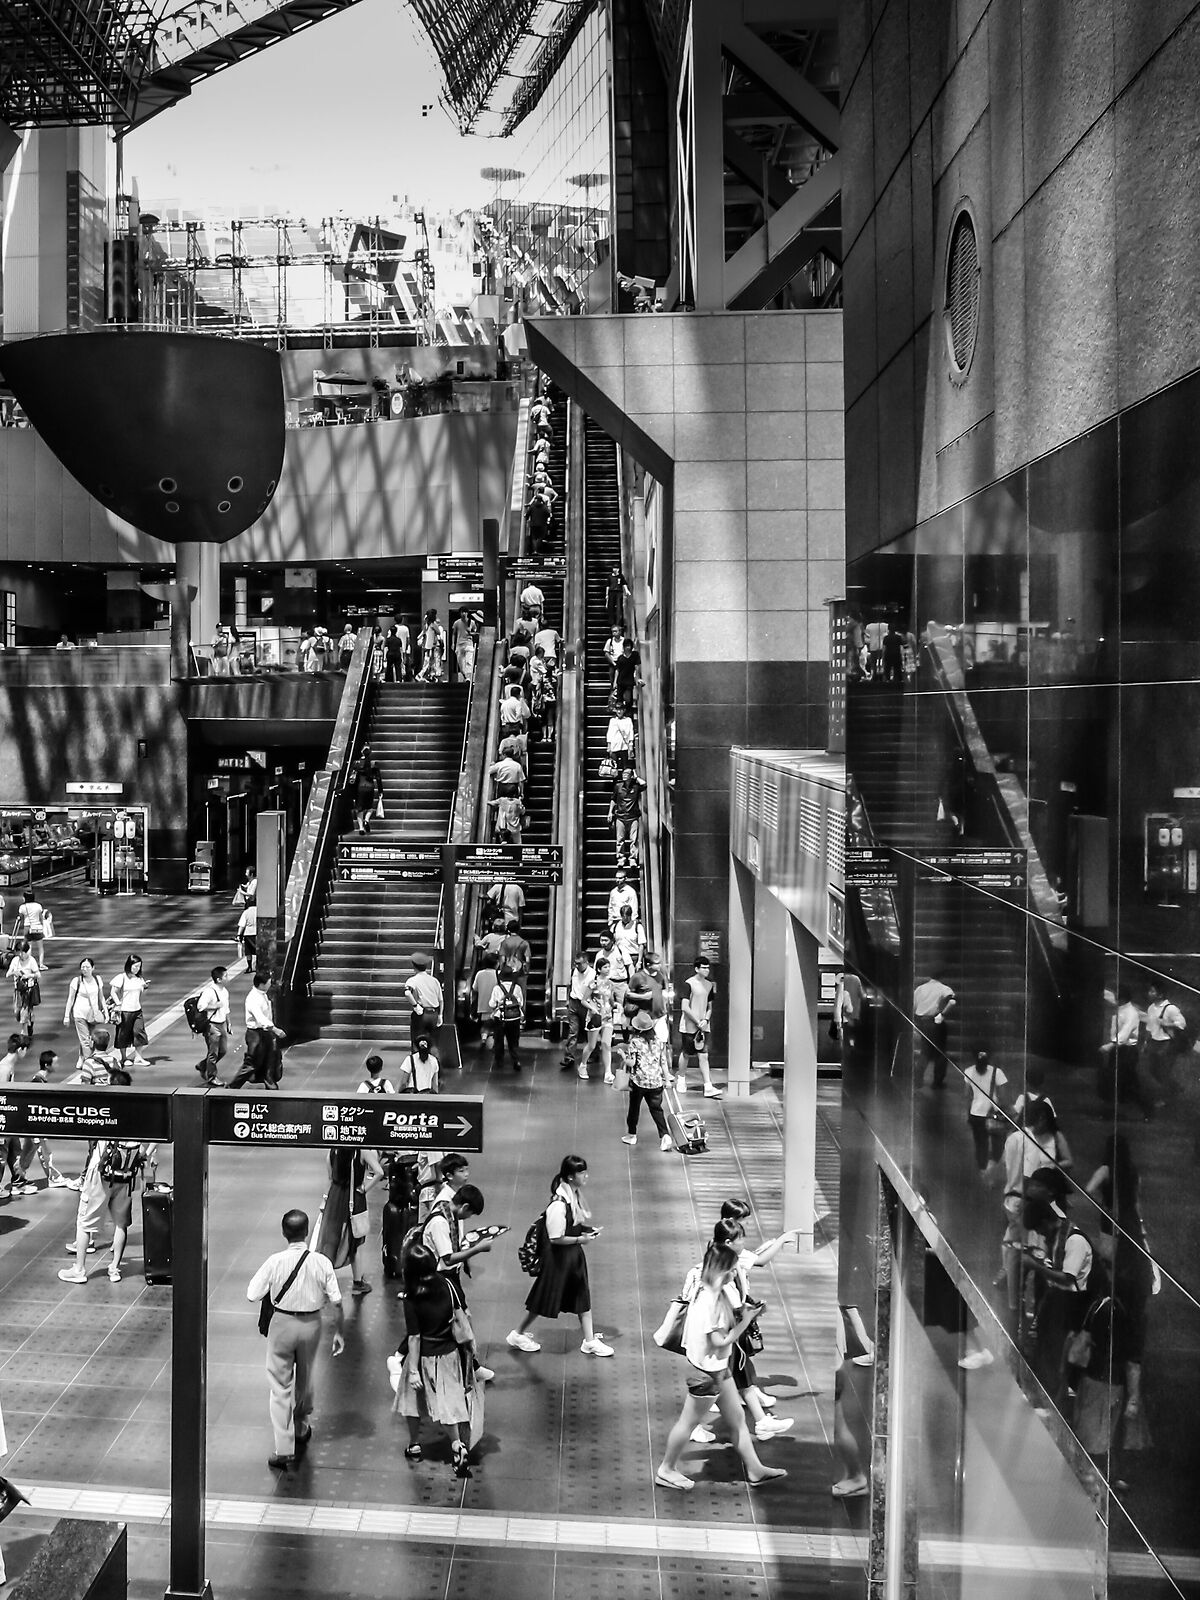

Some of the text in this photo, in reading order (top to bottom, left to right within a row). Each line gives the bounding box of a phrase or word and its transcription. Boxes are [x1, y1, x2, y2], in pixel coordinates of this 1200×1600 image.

[27, 1105, 110, 1117] The CUBE
[251, 1104, 269, 1113] バス
[340, 1106, 374, 1116] タクシー
[77, 1117, 105, 1126] Shopping
[383, 1111, 439, 1126] Porta
[251, 1123, 312, 1134] バス総合案内所
[340, 1125, 367, 1136] 地下鉄
[340, 1134, 365, 1143] Subway
[390, 1130, 432, 1140] Shopping Mall
